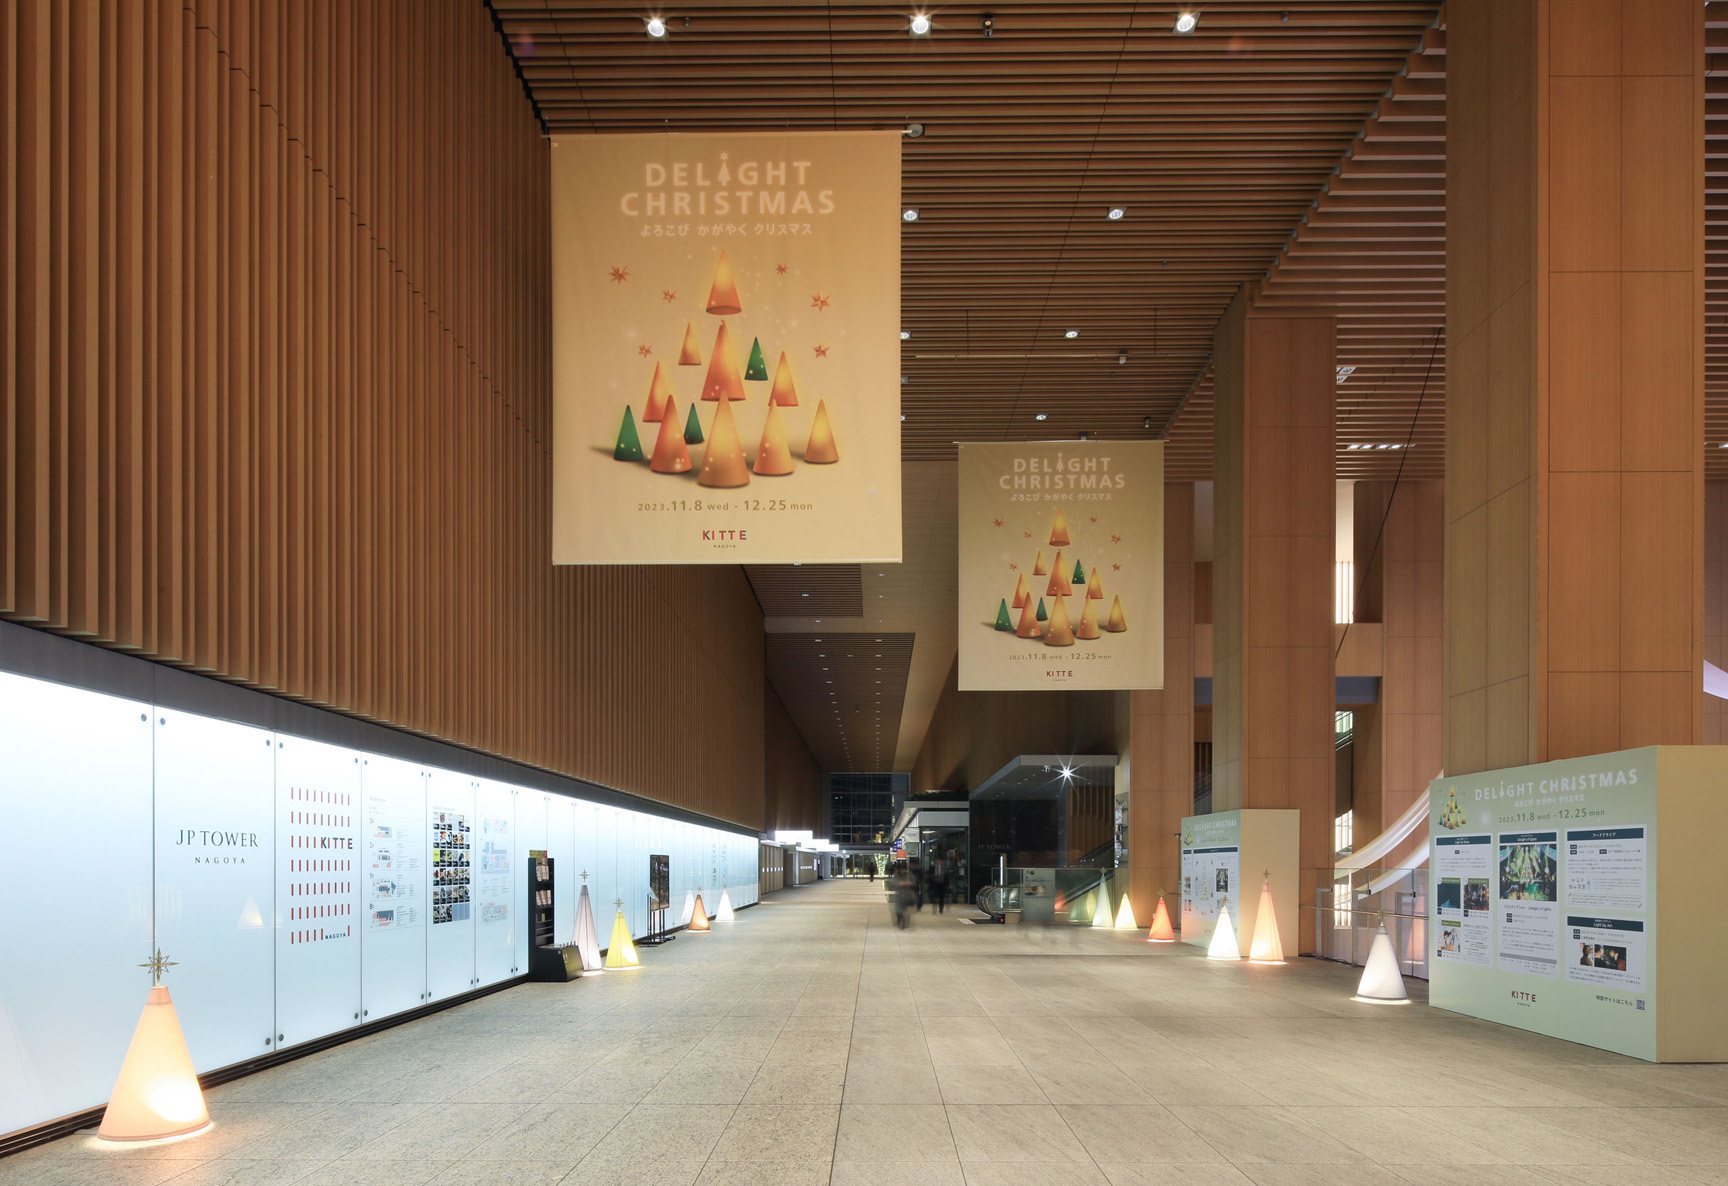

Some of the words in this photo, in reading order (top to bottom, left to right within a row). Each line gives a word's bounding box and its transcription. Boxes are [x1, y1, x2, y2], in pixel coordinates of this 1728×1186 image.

[620, 189, 835, 216] CHRISTMAS
[640, 223, 690, 237] よろこび
[697, 223, 747, 236] かがやく
[753, 222, 813, 236] クリスマス
[999, 474, 1125, 489] CHRISTMAS
[1011, 493, 1040, 501] よろこび
[638, 500, 703, 512] 2023.11.8
[707, 502, 729, 511] wed
[743, 500, 787, 511] 12.25
[702, 530, 747, 541] KITTE
[1539, 769, 1638, 794] CHRISTMAS
[1558, 808, 1587, 819] 12.25
[1589, 809, 1605, 817] mon
[176, 829, 196, 846] JP
[199, 830, 259, 848] TOWER
[320, 836, 353, 850] KITTE
[194, 856, 246, 864] NAGOYA
[324, 932, 347, 940] NAGOYA
[1511, 990, 1537, 1003] KITTE
